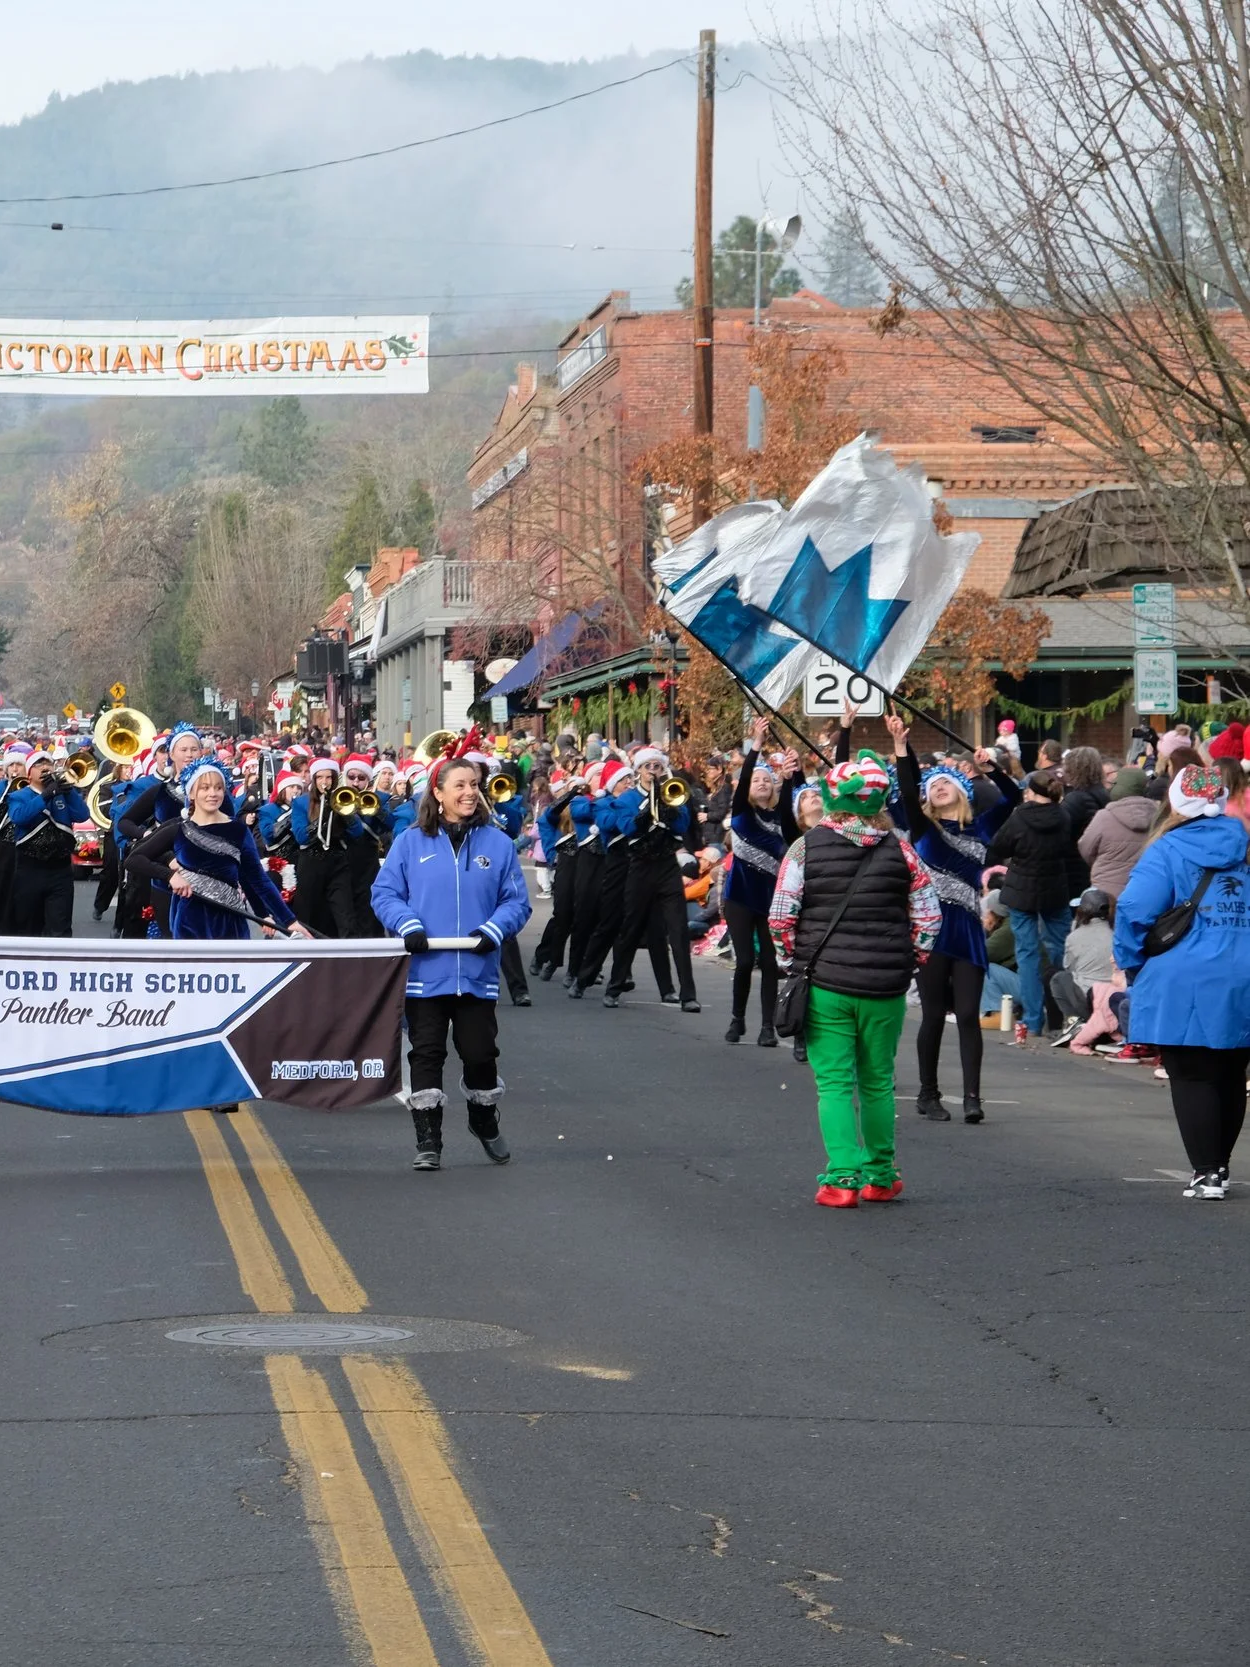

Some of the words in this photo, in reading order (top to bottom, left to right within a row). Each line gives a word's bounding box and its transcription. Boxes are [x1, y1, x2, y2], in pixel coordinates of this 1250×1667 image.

[176, 338, 387, 380] CHRISTMAS
[815, 673, 872, 705] 20
[1141, 680, 1171, 688] PARKING
[1216, 901, 1246, 914] SMHS
[1205, 916, 1250, 928] PANTHE
[69, 972, 133, 993] HIGH
[144, 973, 247, 994] SCHOOL
[96, 999, 176, 1028] Band
[271, 1060, 358, 1081] MEDFORD,
[362, 1059, 385, 1079] OR
